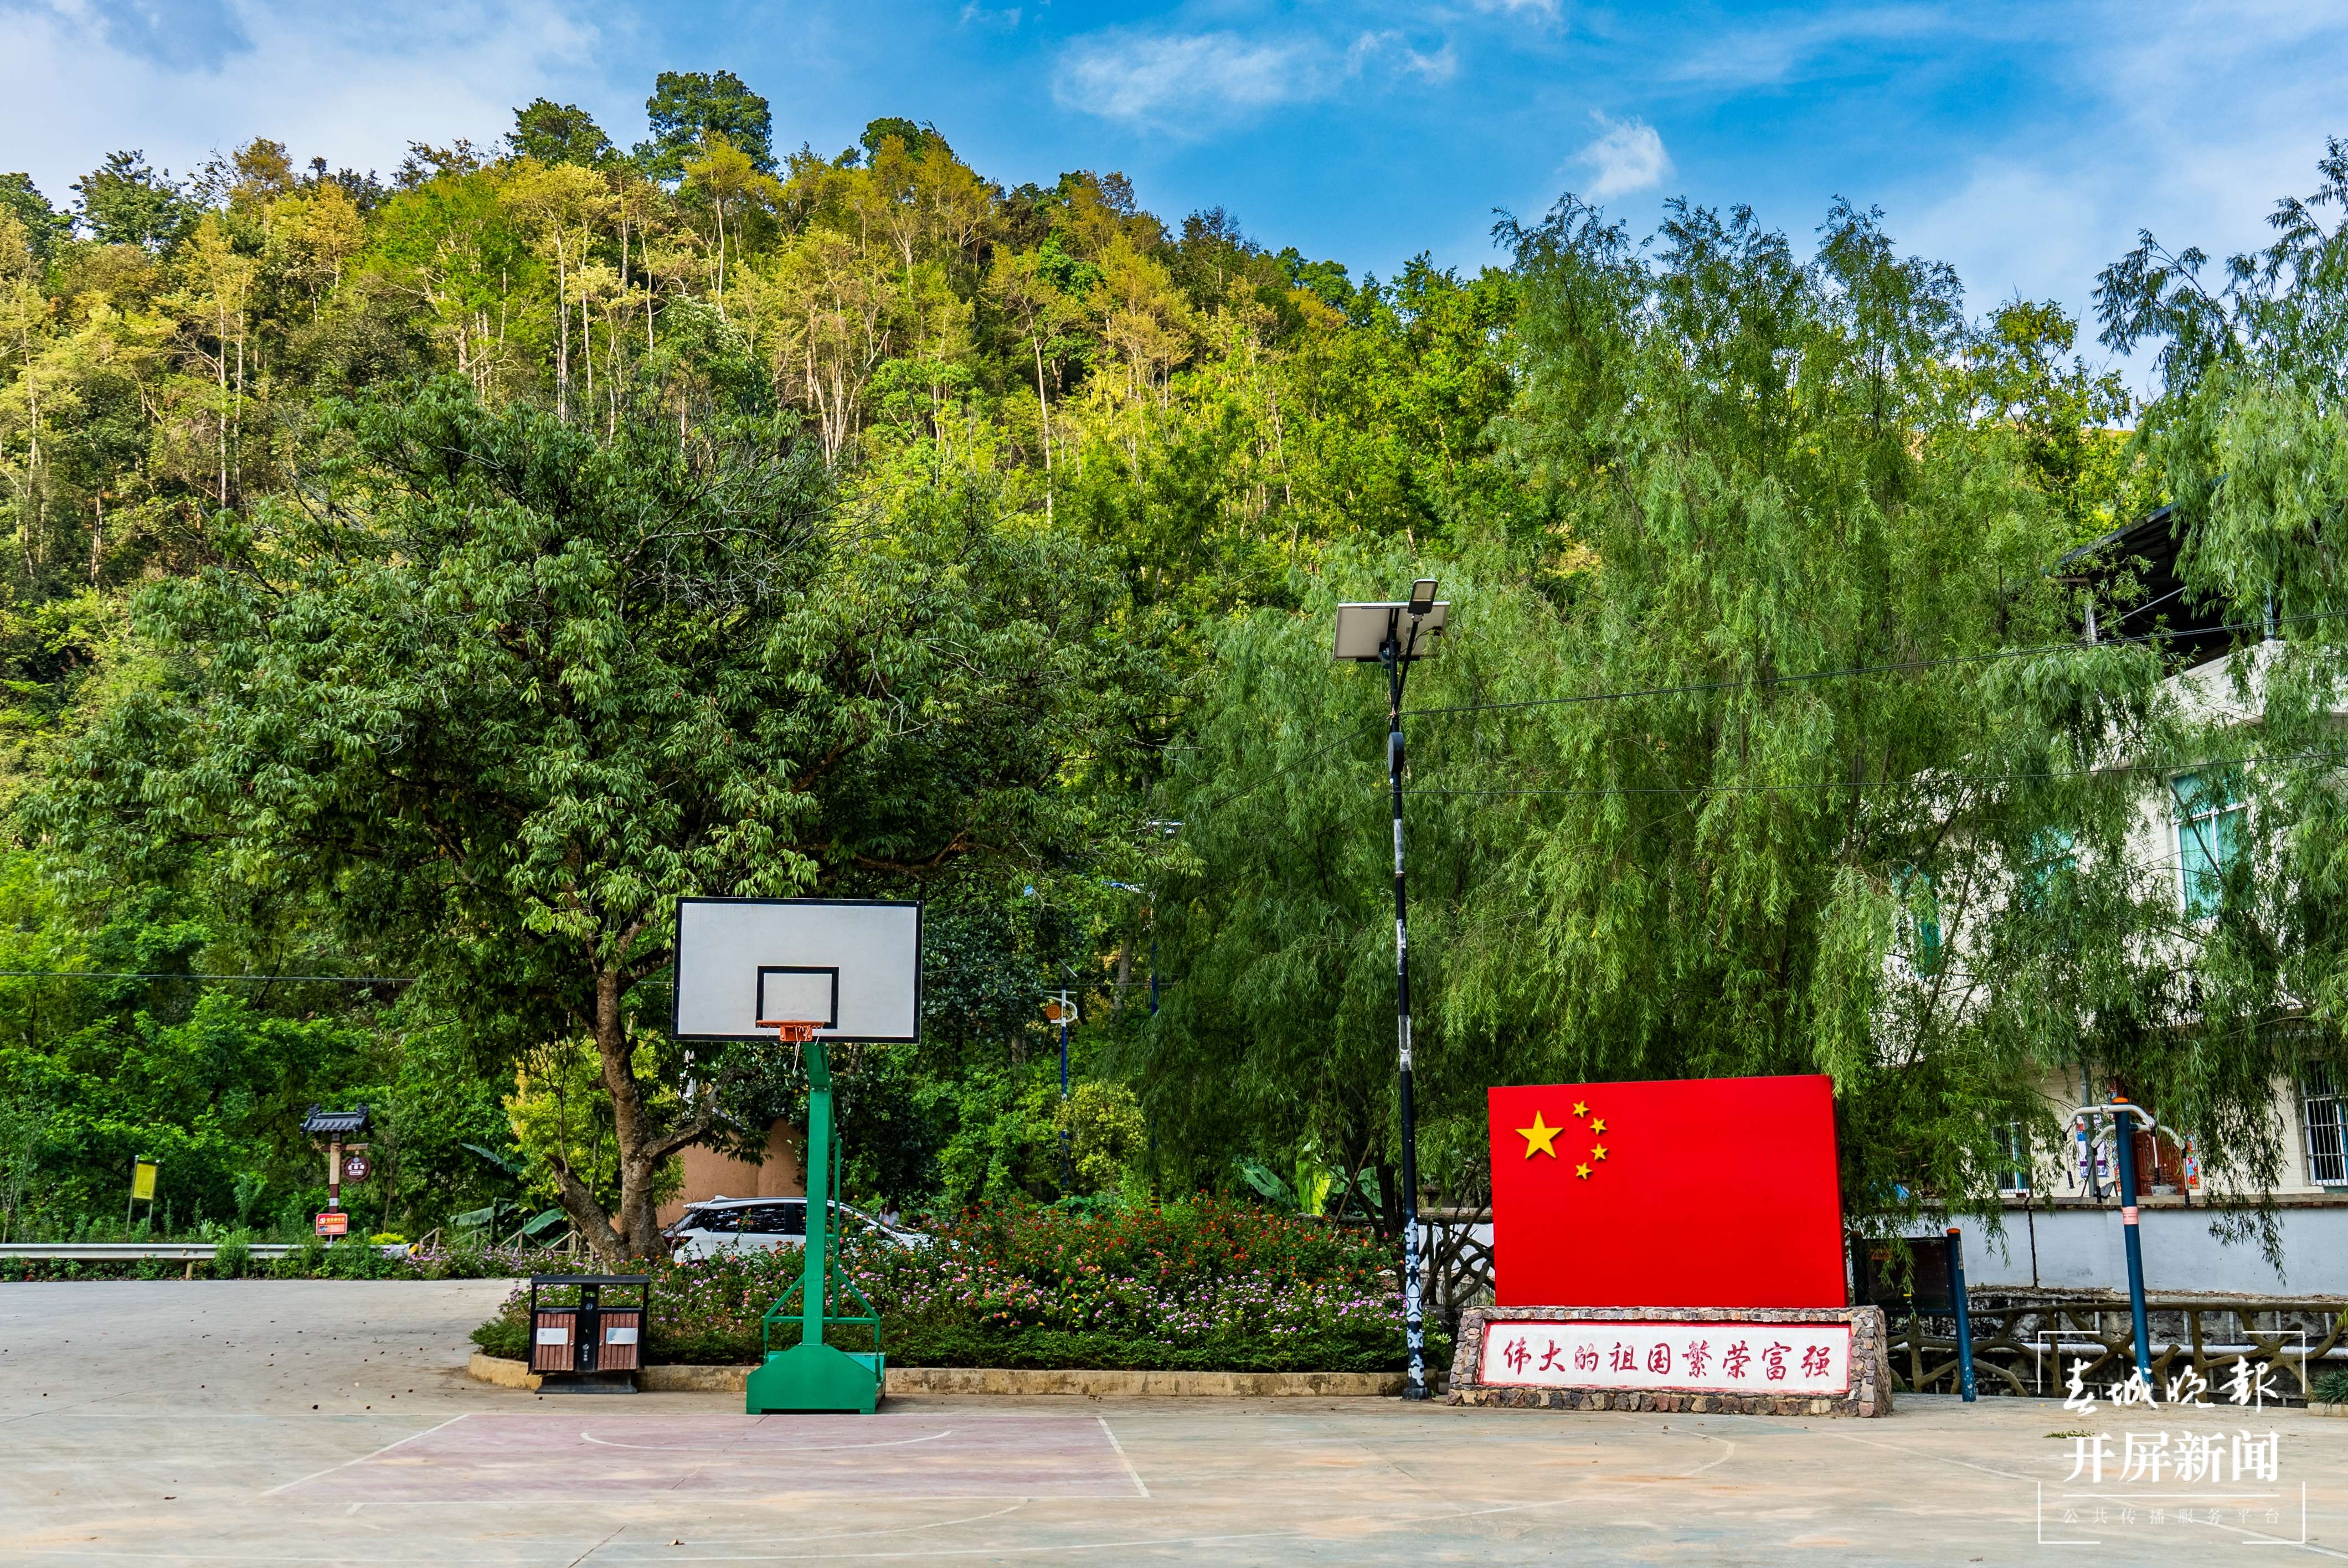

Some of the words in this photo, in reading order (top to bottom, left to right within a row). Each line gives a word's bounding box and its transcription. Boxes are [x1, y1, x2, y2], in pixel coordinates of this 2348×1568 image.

[1503, 1336, 1830, 1381] 伟大的祖国繁荣富强
